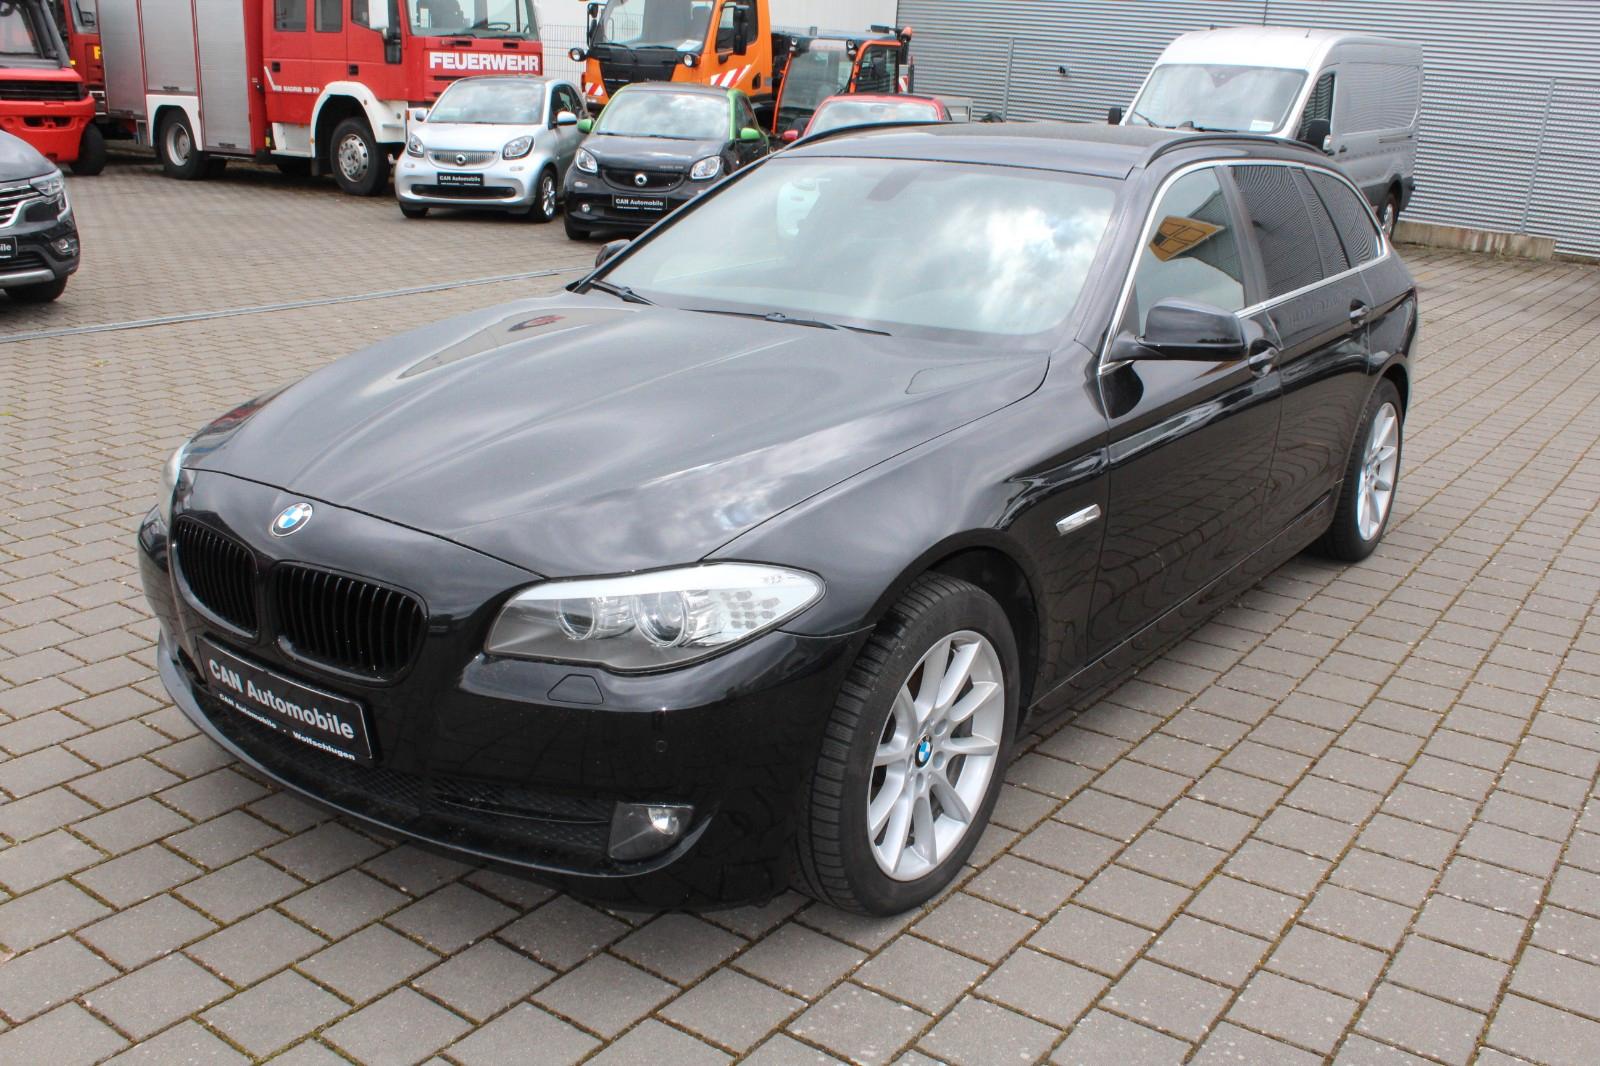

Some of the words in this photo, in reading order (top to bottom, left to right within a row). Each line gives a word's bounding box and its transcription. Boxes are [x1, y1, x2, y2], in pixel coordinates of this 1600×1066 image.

[429, 52, 539, 71] FEUERWEHR
[209, 659, 243, 693] CAN
[247, 679, 354, 739] Automobile
[219, 693, 234, 706] CAN
[236, 703, 277, 729] Automobile
[292, 731, 356, 760] Wolfschlugen
